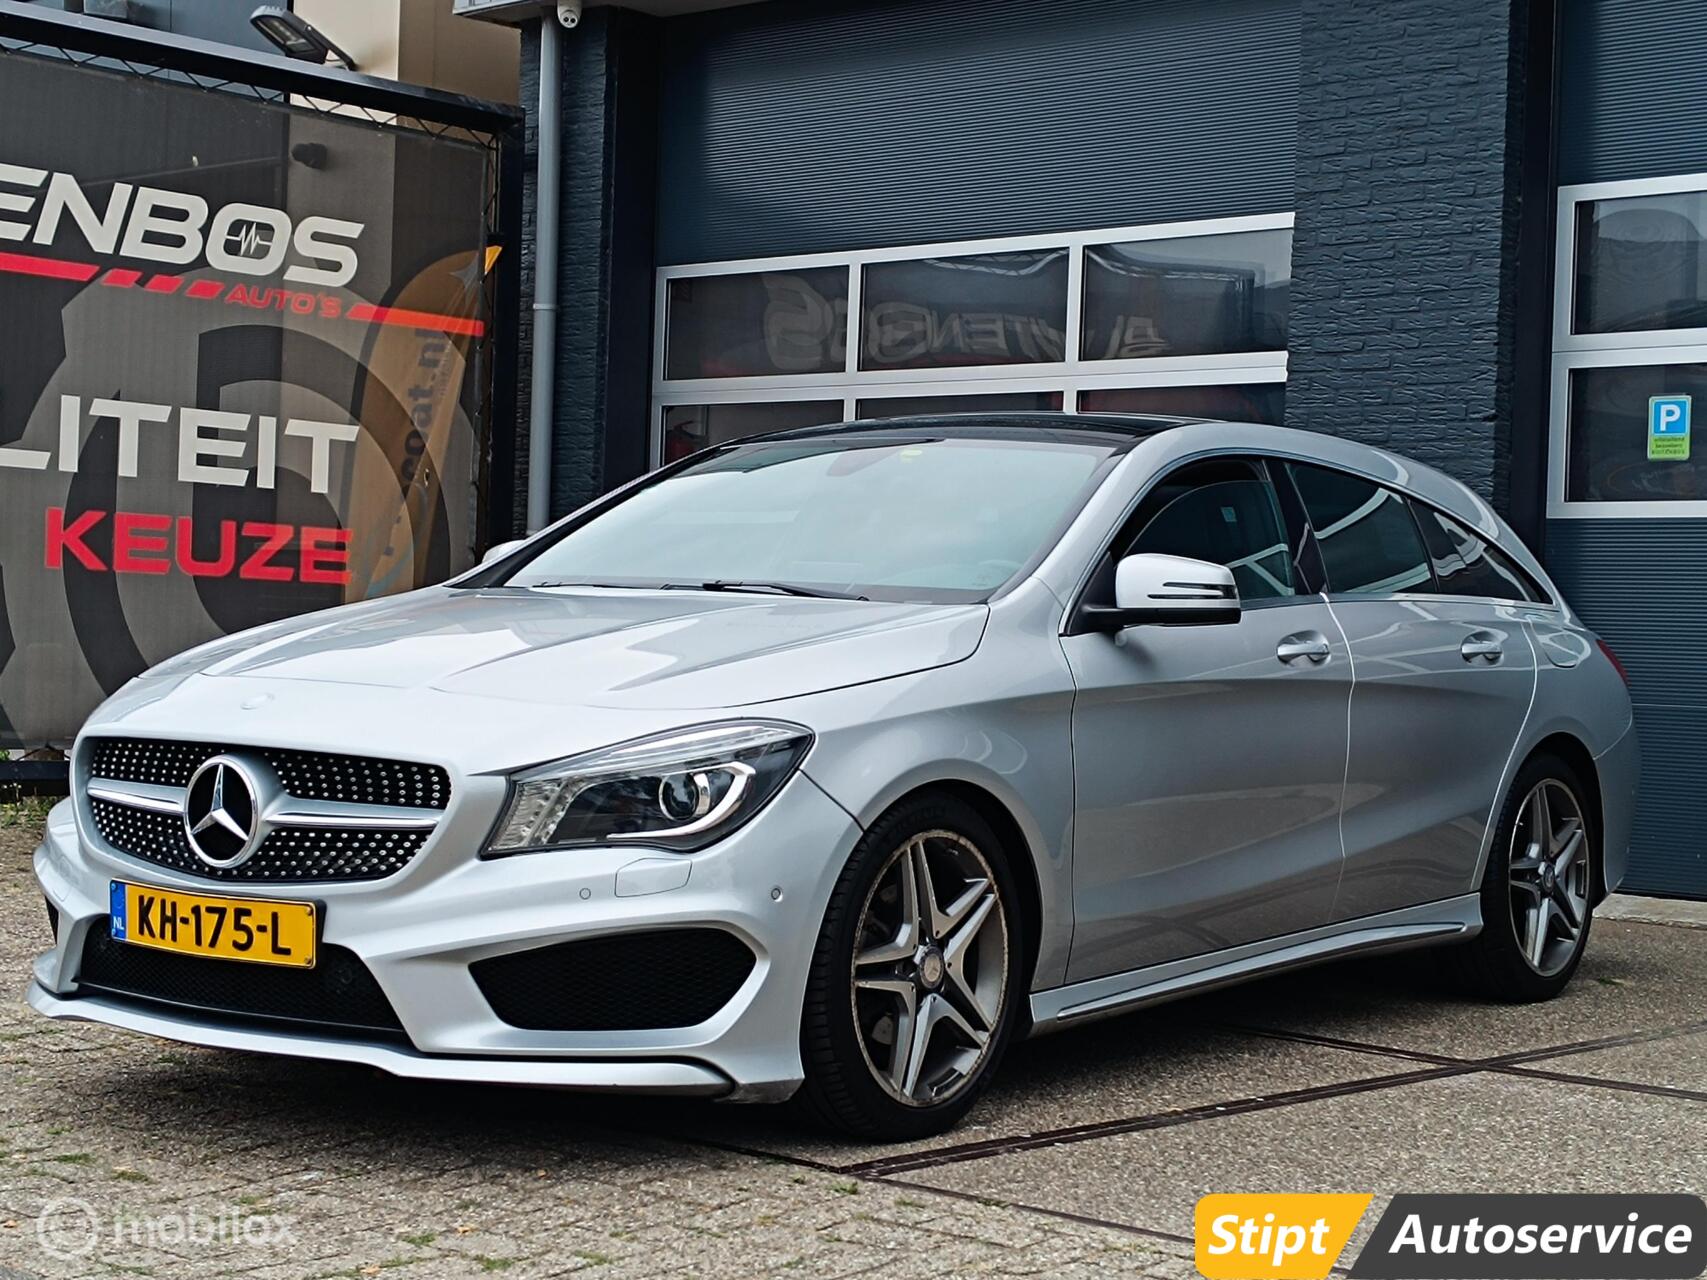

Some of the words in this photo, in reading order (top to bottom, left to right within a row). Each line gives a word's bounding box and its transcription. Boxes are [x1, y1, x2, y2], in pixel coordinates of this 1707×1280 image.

[0, 163, 365, 288] ENBOS
[224, 282, 343, 318] AUTO'S
[1660, 404, 1681, 431] P
[44, 507, 353, 586] KEUZE
[113, 915, 125, 931] NL
[138, 894, 292, 956] KH-175-L
